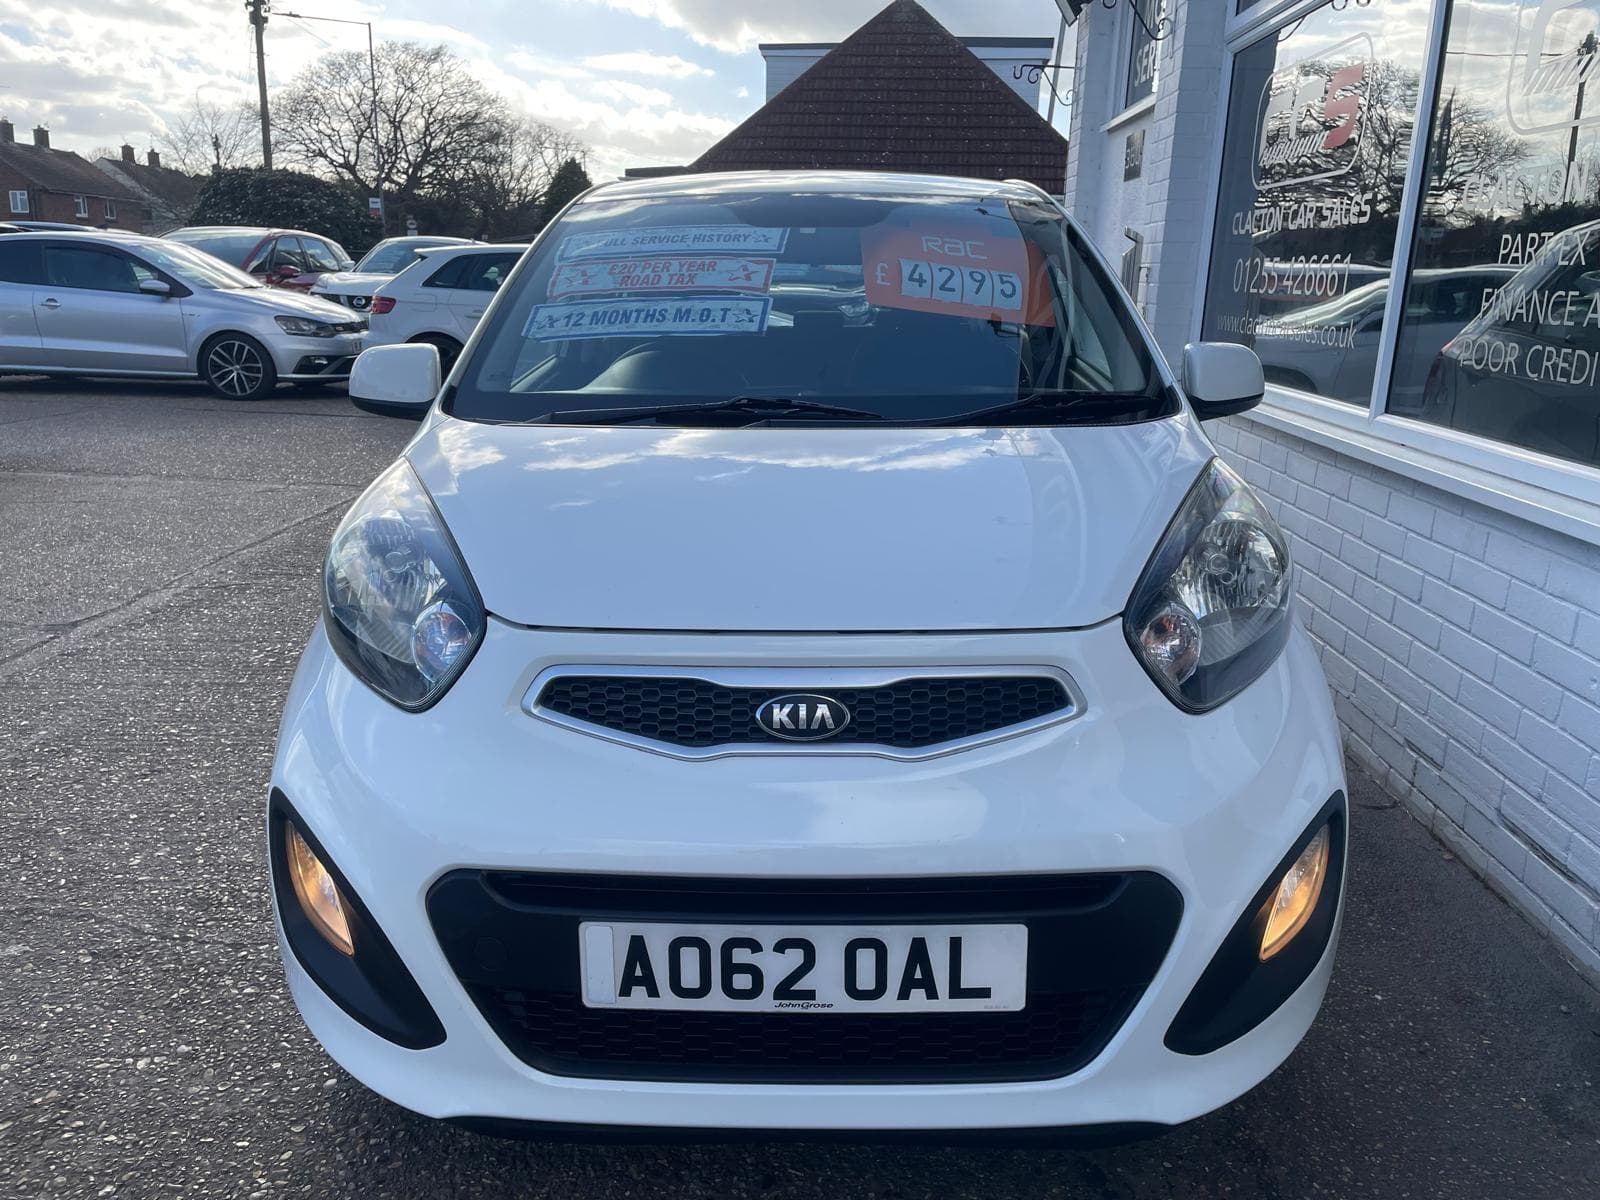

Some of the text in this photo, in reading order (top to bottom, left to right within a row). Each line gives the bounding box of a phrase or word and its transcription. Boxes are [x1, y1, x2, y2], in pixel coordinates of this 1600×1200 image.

[1232, 193, 1373, 235] CLACTON CAR SALES
[631, 234, 690, 246] SERVICE
[692, 232, 751, 244] HISTORY
[1498, 231, 1592, 266] PART EX
[608, 260, 718, 276] £20 PER YEAR
[619, 272, 698, 287] ROAD TAX
[1233, 253, 1352, 296] 01255 426661
[562, 311, 583, 327] 12
[588, 307, 668, 326] MONTHS
[1480, 288, 1580, 327] FINANCE
[1459, 338, 1519, 375] POOR
[771, 703, 836, 729] KIA
[617, 934, 992, 1001] AO62 OAL
